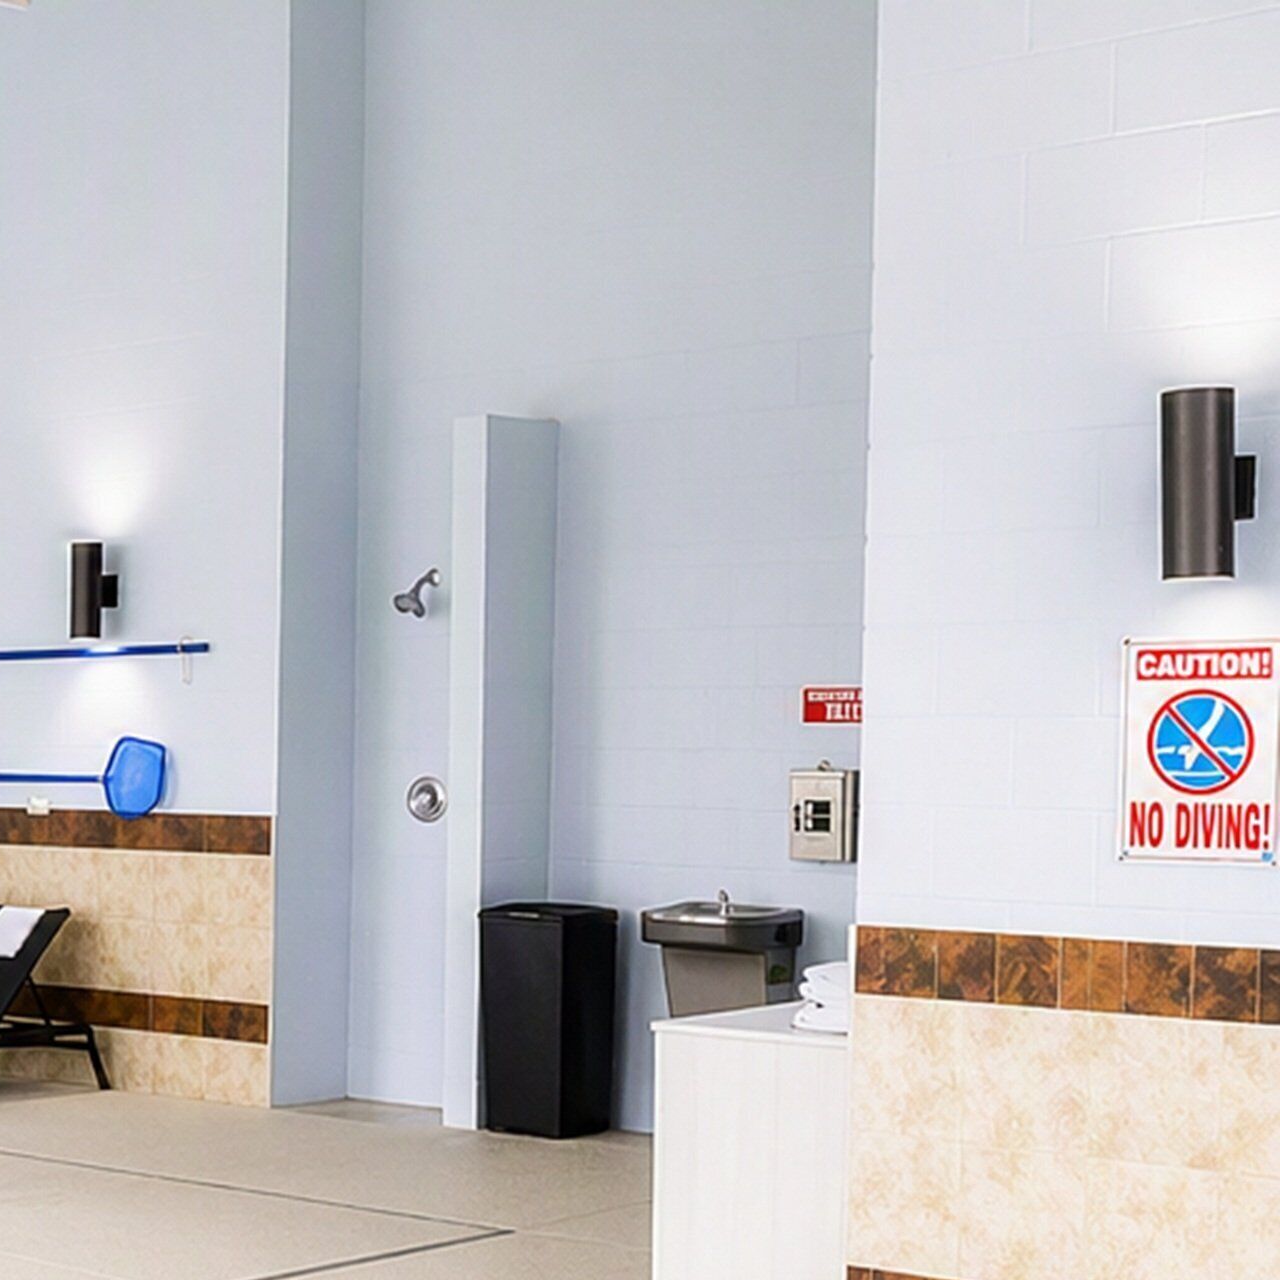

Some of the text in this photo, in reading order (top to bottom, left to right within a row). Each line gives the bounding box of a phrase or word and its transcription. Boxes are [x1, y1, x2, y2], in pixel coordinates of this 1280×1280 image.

[1139, 651, 1271, 677] CAUTION!
[1129, 802, 1271, 850] NO DIVING!
